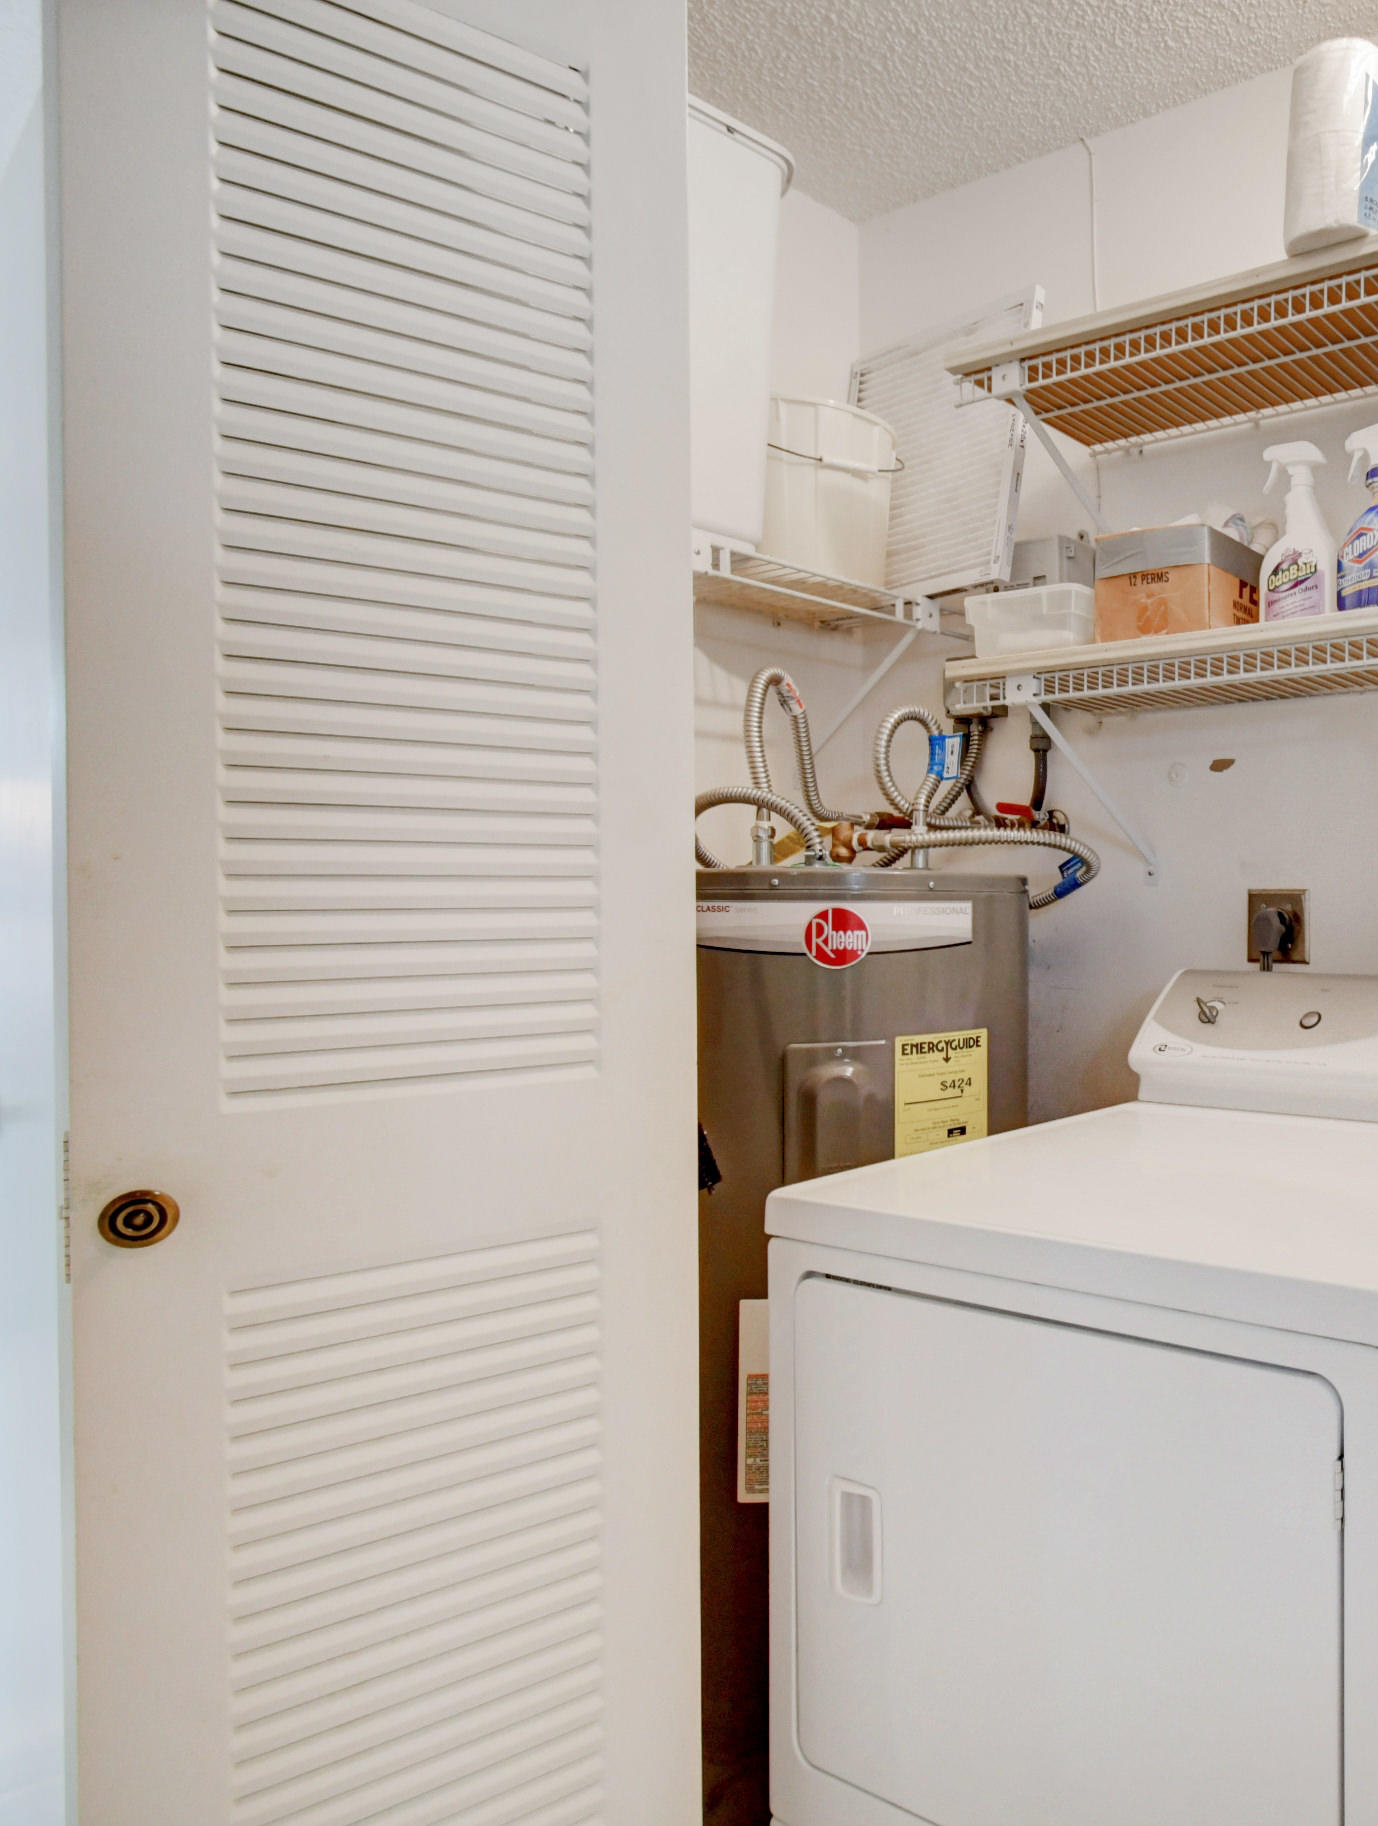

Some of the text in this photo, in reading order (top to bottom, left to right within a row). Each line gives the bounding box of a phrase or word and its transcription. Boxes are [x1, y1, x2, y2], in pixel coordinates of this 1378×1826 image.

[1129, 571, 1170, 587] 12 PERMS
[1268, 559, 1317, 591] OdoBan
[696, 905, 731, 913] CLASSIC
[812, 907, 867, 958] Rheem
[901, 1035, 982, 1060] ENERGYGUIDE
